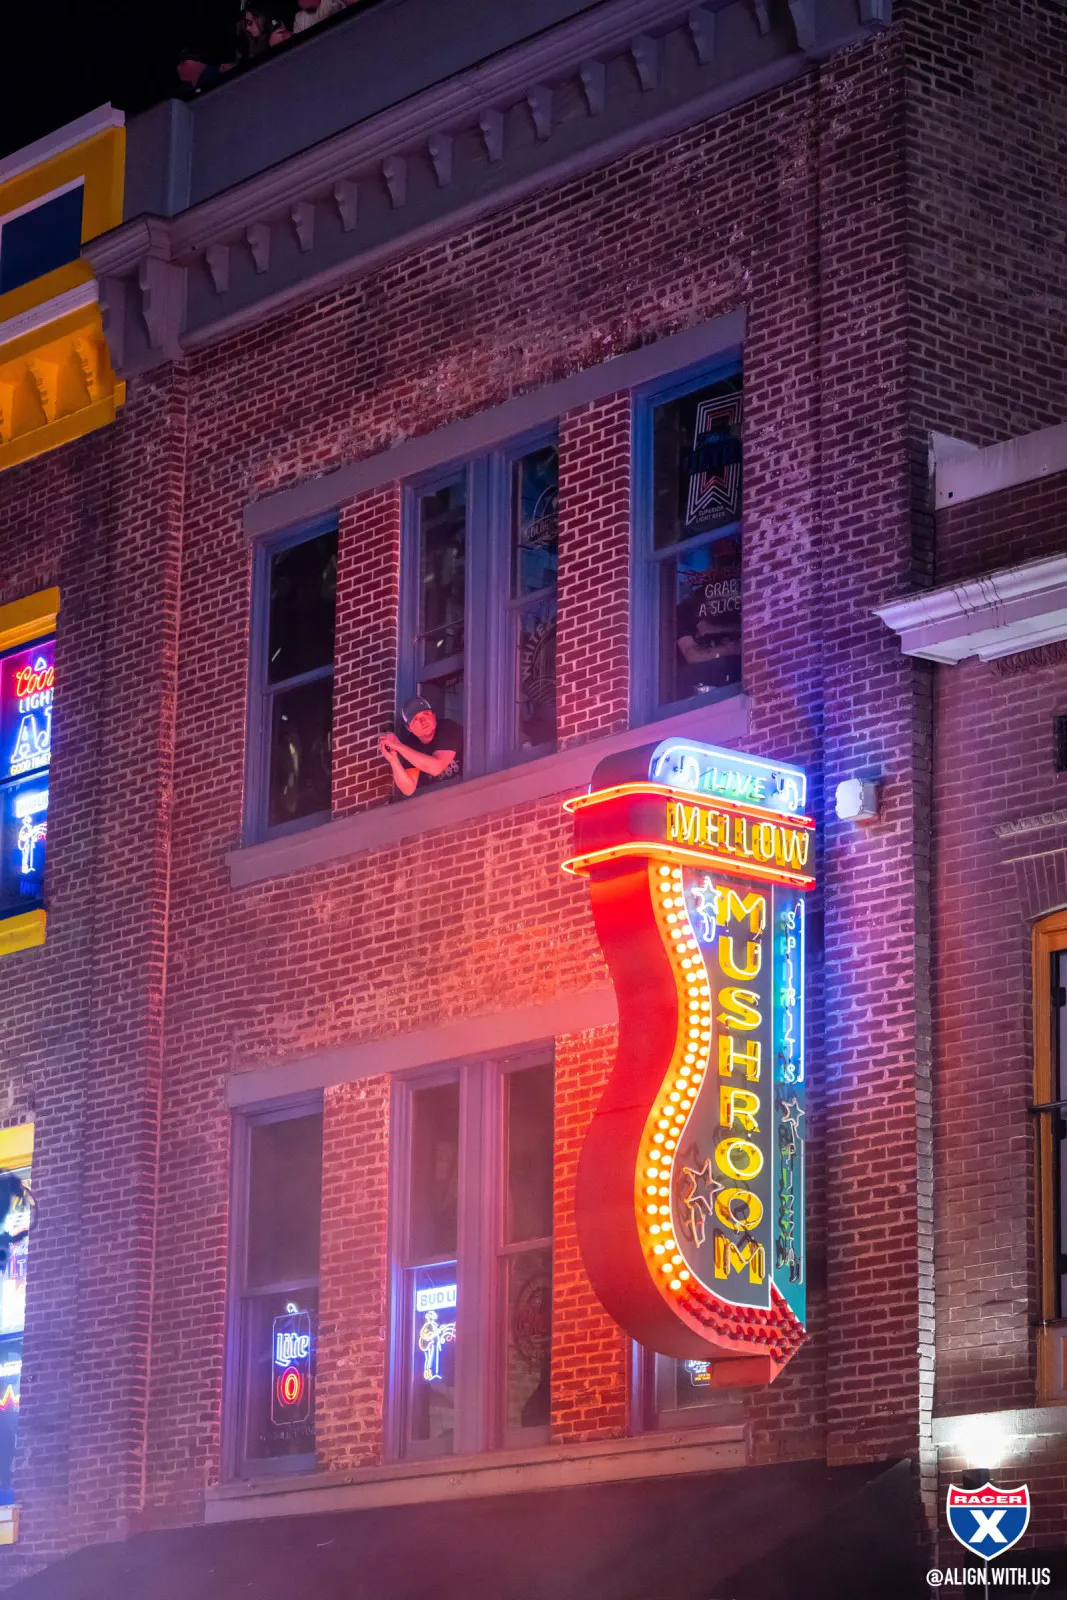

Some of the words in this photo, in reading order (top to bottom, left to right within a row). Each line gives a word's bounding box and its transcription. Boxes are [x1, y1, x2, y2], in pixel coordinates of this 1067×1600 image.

[704, 578, 737, 598] GRAB
[698, 602, 707, 617] A
[710, 595, 741, 615] SLICE
[521, 622, 547, 682] WHITE
[703, 768, 766, 799] LIVE
[667, 801, 810, 870] MELLOW
[714, 885, 766, 1285] MUSHROOM
[420, 1292, 444, 1307] BUD
[275, 1333, 309, 1367] Lite
